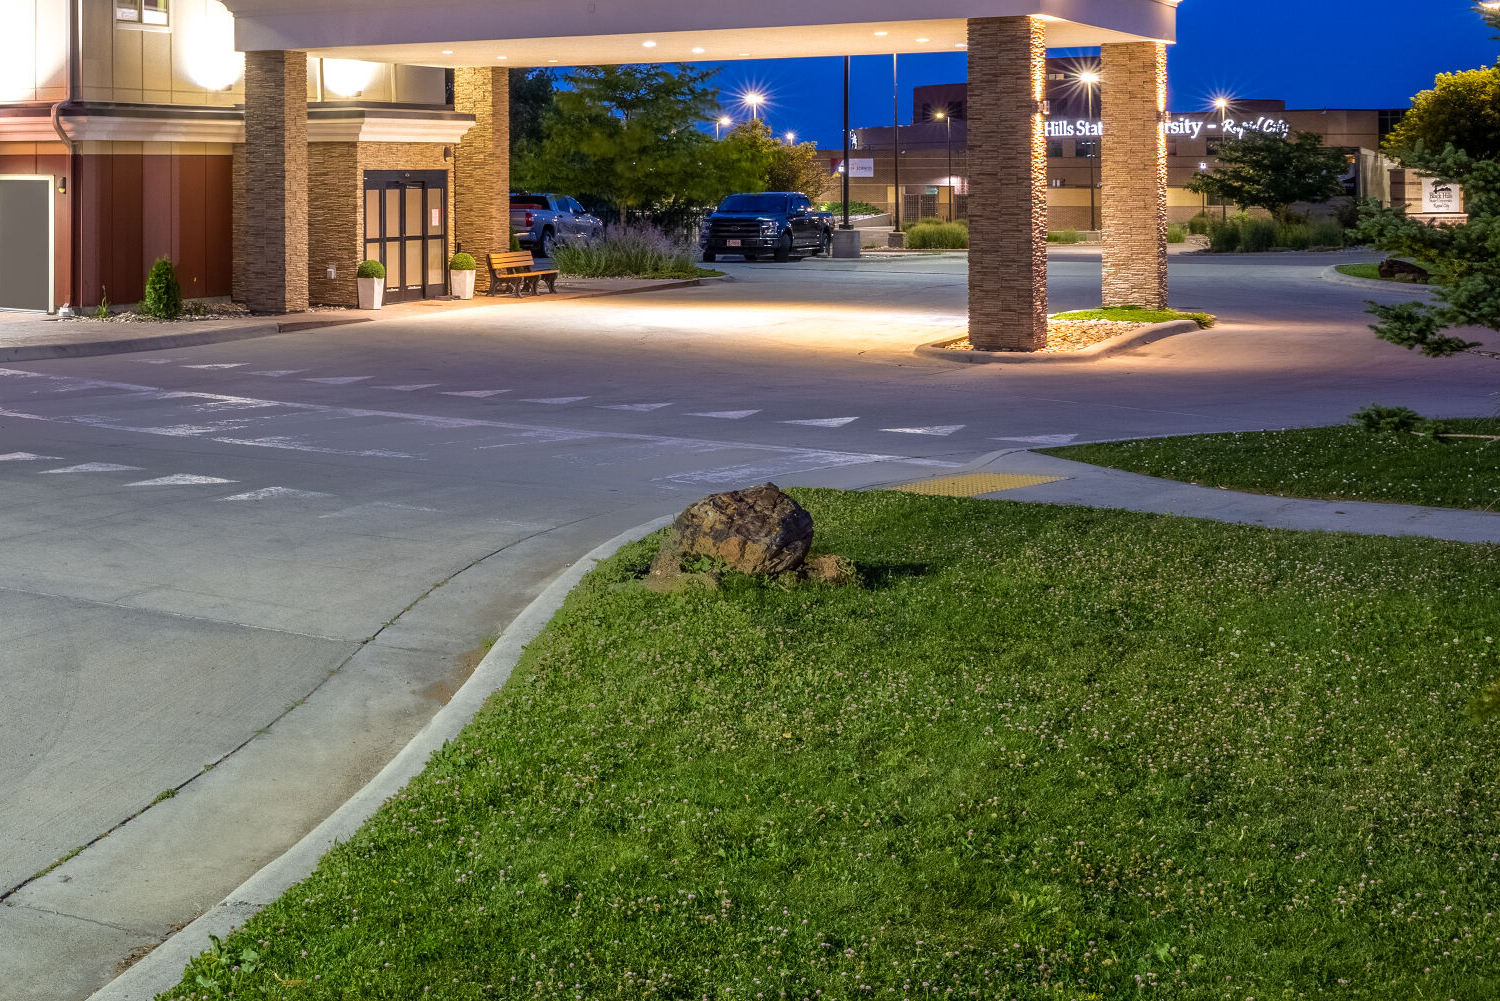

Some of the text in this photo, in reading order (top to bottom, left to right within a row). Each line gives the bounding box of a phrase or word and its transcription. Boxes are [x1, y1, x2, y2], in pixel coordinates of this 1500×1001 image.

[1044, 120, 1075, 137] Hills
[1075, 120, 1104, 136] Stat
[1164, 118, 1204, 139] rsity
